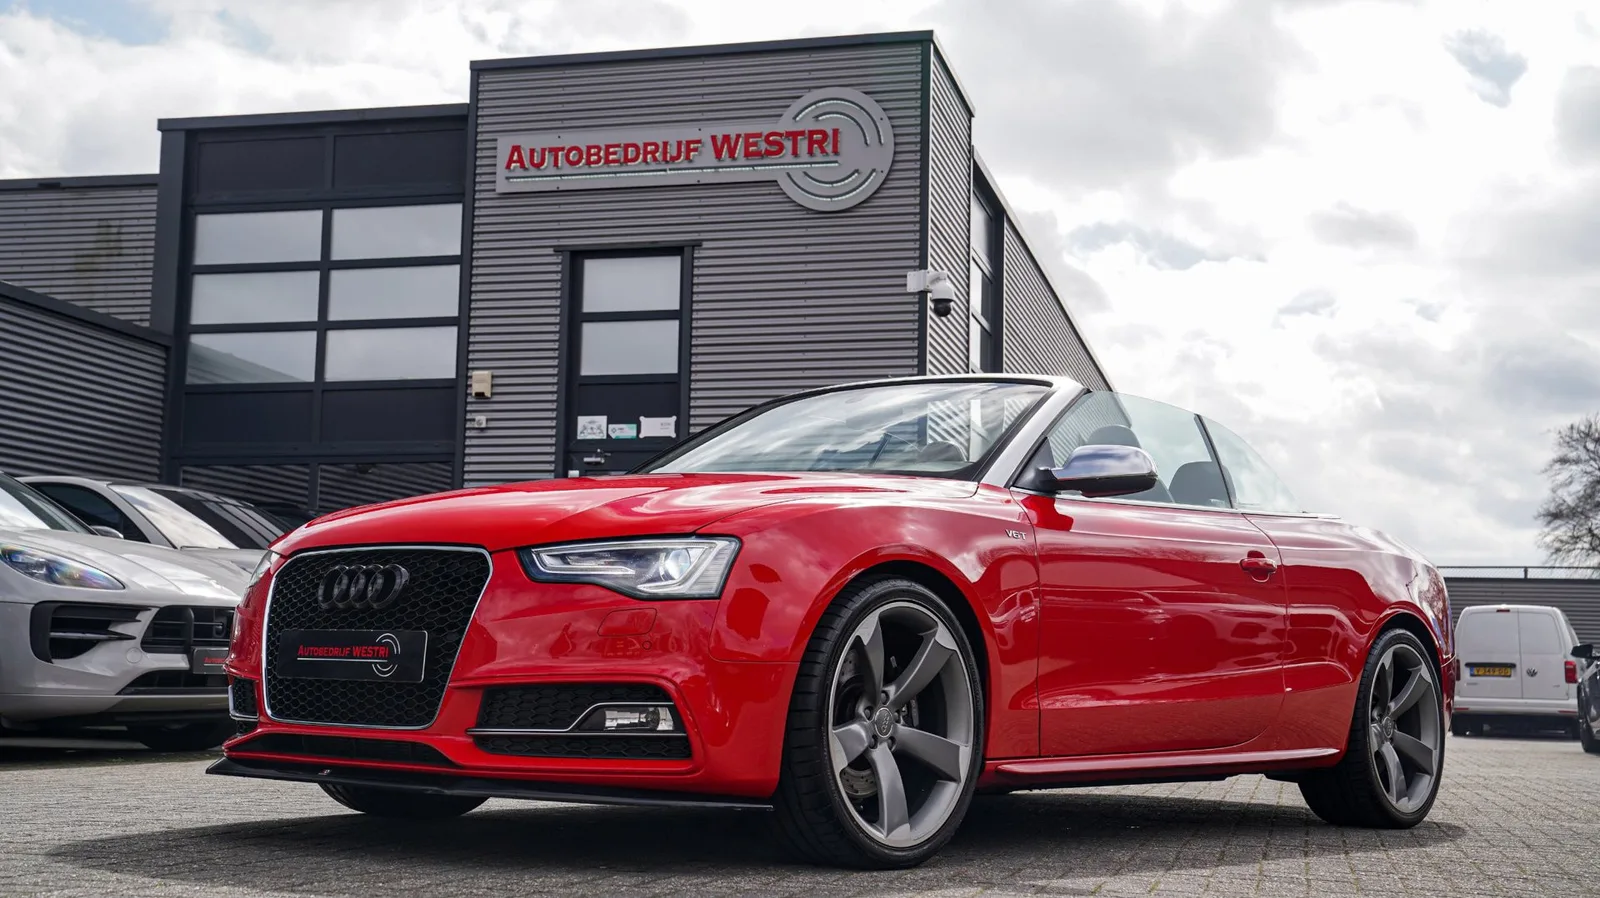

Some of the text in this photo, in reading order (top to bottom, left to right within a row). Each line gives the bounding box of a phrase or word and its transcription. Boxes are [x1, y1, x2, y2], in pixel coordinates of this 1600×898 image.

[505, 128, 841, 170] AUTOBEDRIJF WESTRI
[1005, 529, 1026, 540] V6T
[297, 644, 390, 658] AUTOBEDRIJF WESTRI
